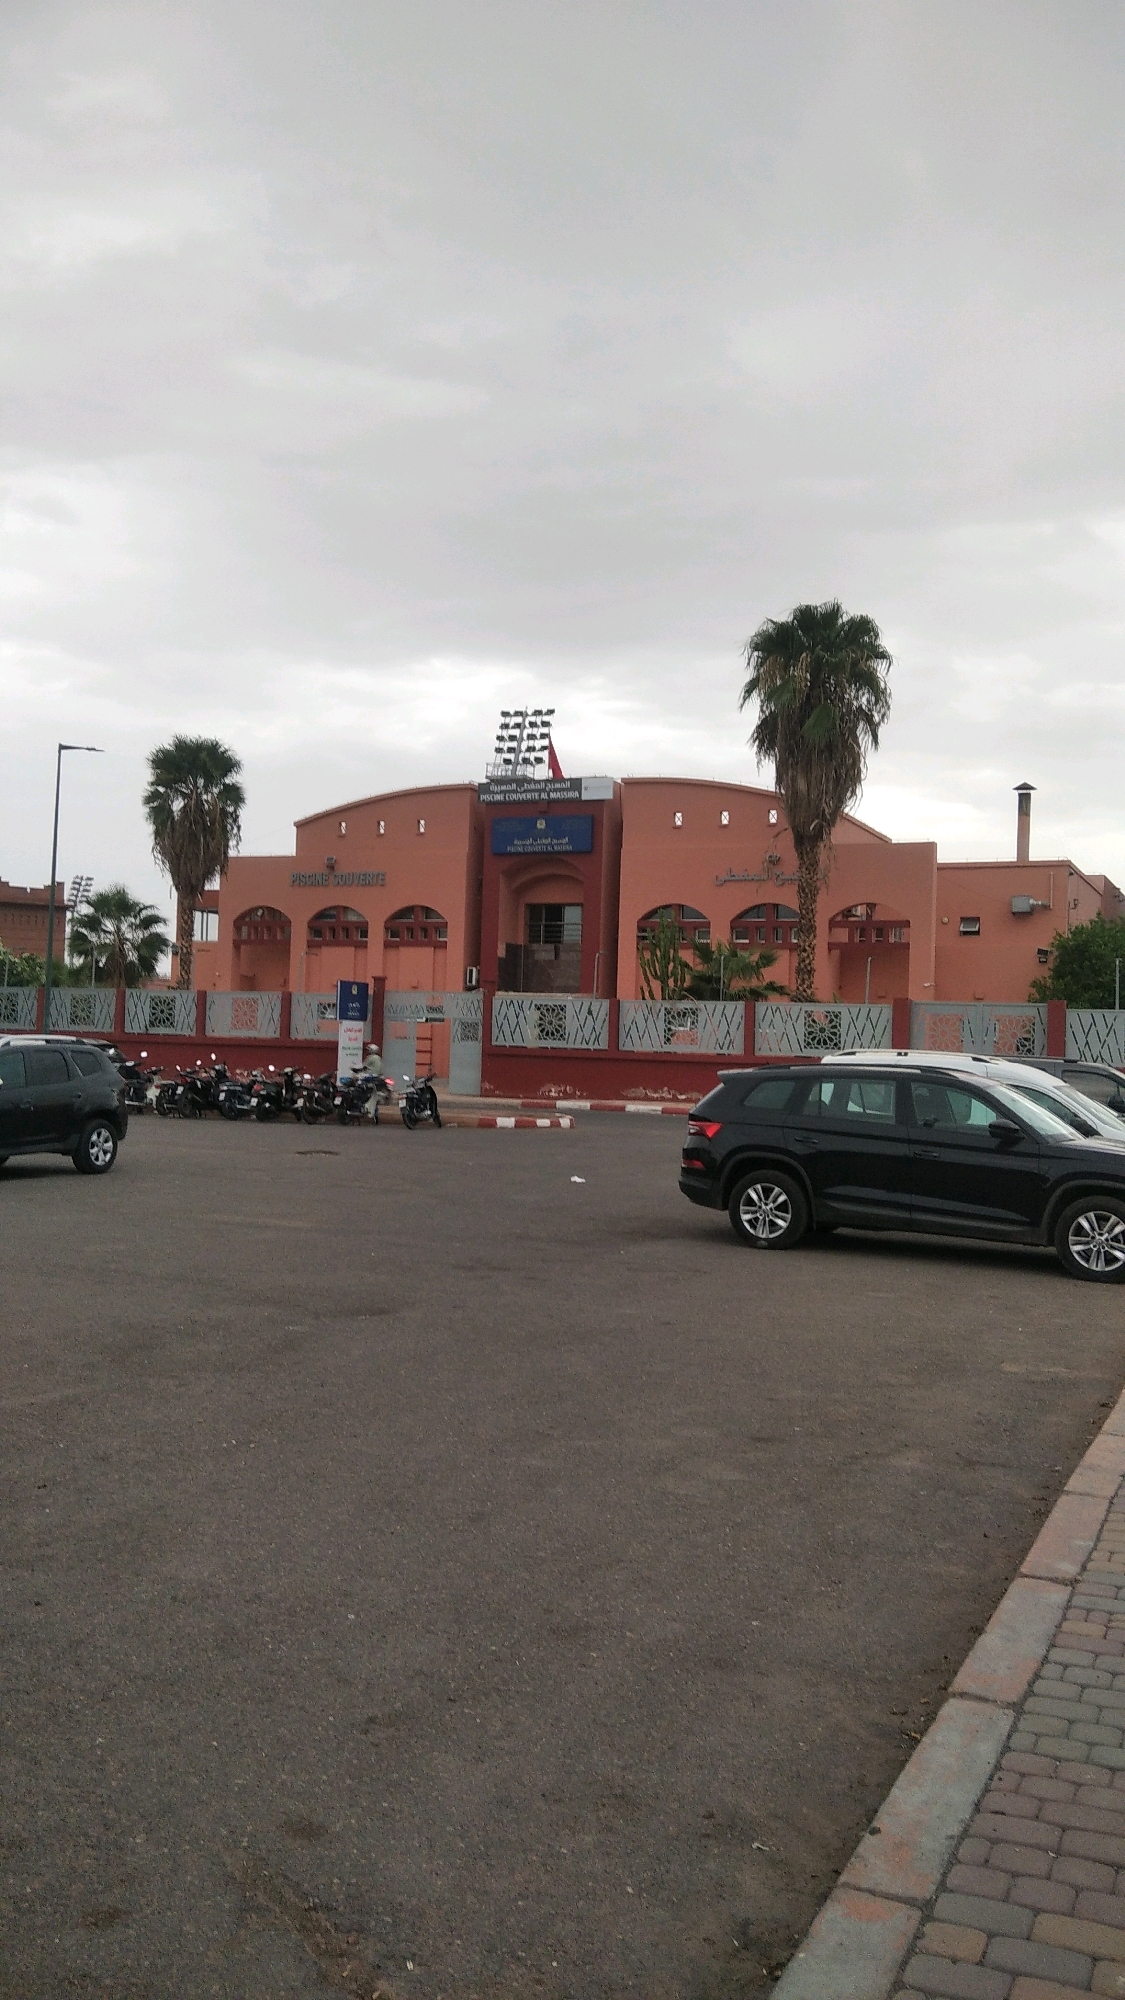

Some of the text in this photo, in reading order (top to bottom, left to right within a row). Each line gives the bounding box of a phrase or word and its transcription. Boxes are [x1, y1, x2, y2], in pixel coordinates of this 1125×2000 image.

[480, 790, 579, 802] PISCINE COUVERTE AL MASSIRA
[291, 871, 386, 887] PISCINE COUVERTE
